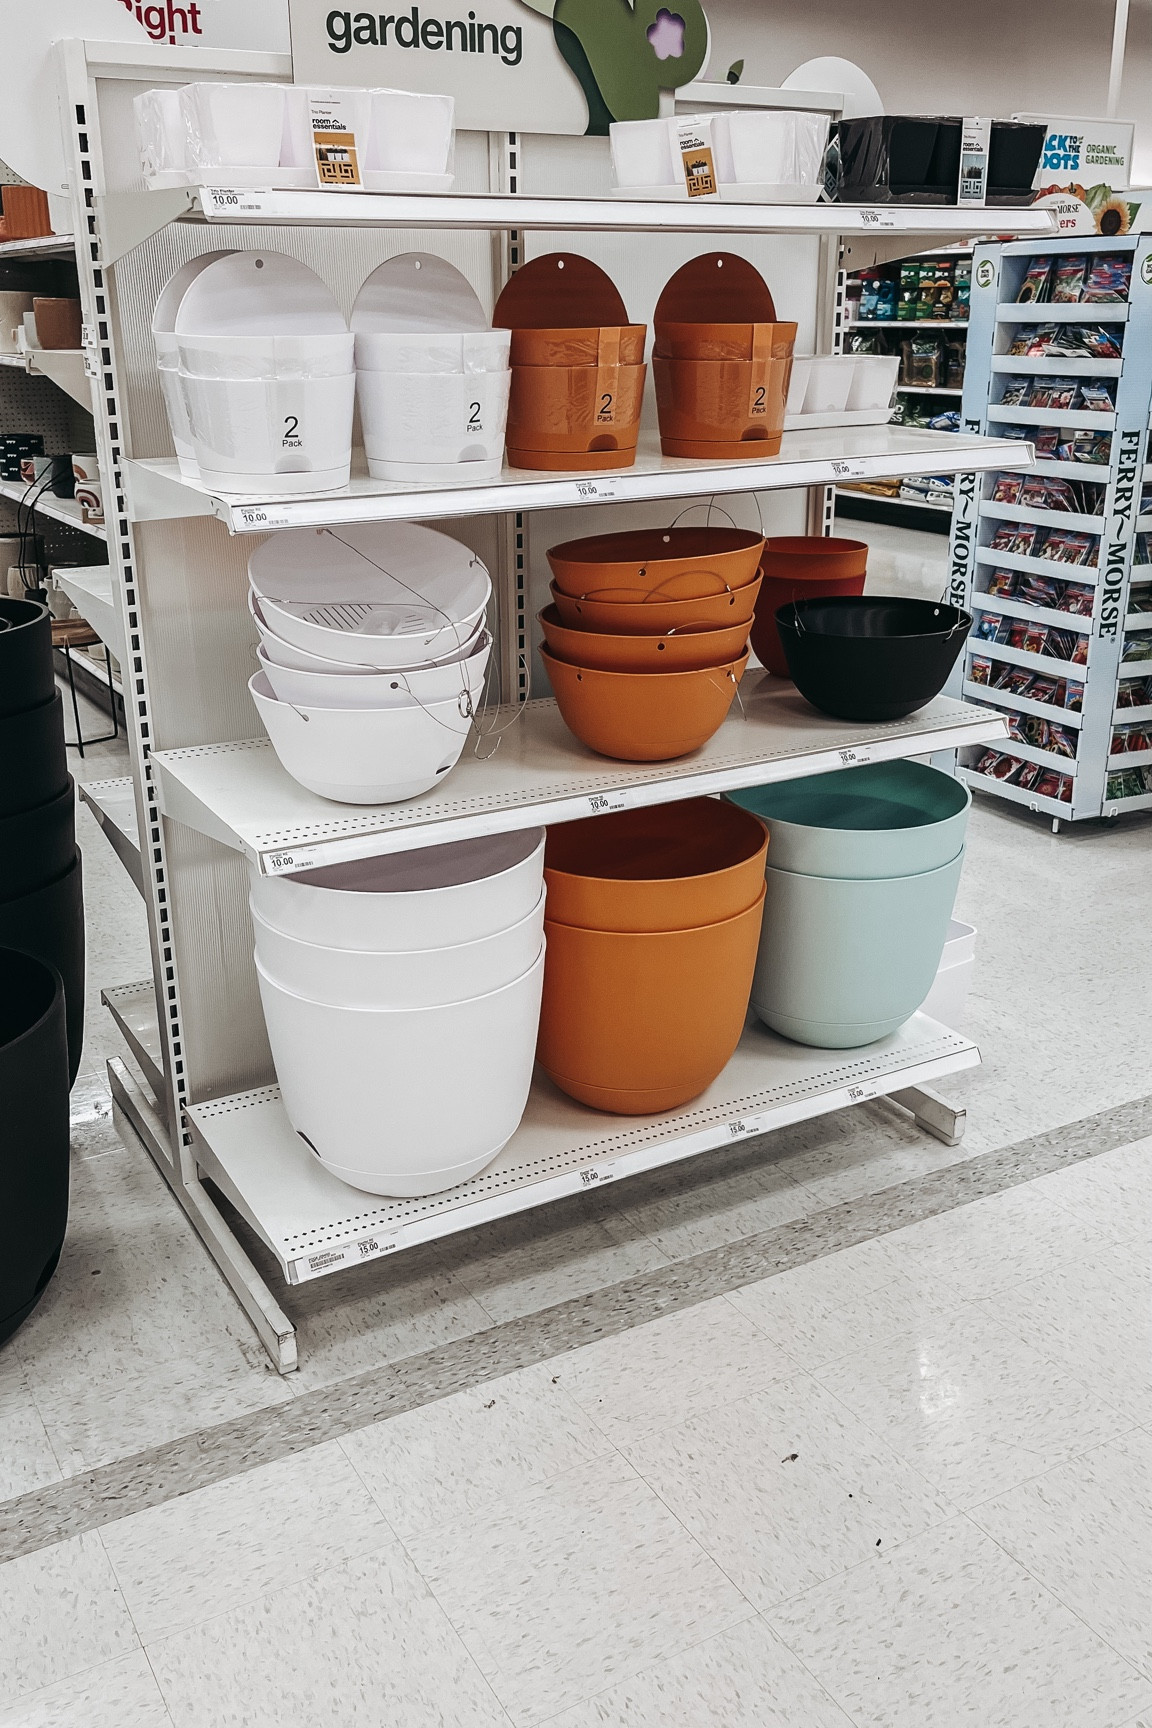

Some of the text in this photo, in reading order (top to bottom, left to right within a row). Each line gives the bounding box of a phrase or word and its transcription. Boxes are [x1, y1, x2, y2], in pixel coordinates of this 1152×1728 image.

[326, 7, 522, 66] gardening
[312, 123, 347, 131] essentials
[1069, 135, 1078, 144] TO
[680, 140, 705, 150] essentials
[1068, 144, 1081, 153] THE
[1086, 144, 1117, 155] ORGANIC
[1085, 155, 1125, 166] GARDENING
[212, 195, 239, 205] 10.00
[754, 386, 766, 407] 2
[599, 393, 613, 415] 2
[469, 401, 481, 424] 2
[751, 405, 767, 415] Pack
[597, 414, 614, 423] Pack
[284, 415, 299, 438] 2
[466, 423, 483, 432] Pack
[282, 439, 303, 448] Pack
[833, 465, 850, 474] 10.00
[577, 486, 598, 496] 10.00
[242, 513, 267, 522] 10.00
[840, 753, 856, 763] 10.00
[590, 799, 609, 809] 10.00
[271, 856, 294, 868] 10.00
[849, 1089, 864, 1099] 15.00
[730, 1124, 746, 1134] 15.00
[581, 1172, 599, 1183] 15.00
[359, 1242, 379, 1254] 15.00
